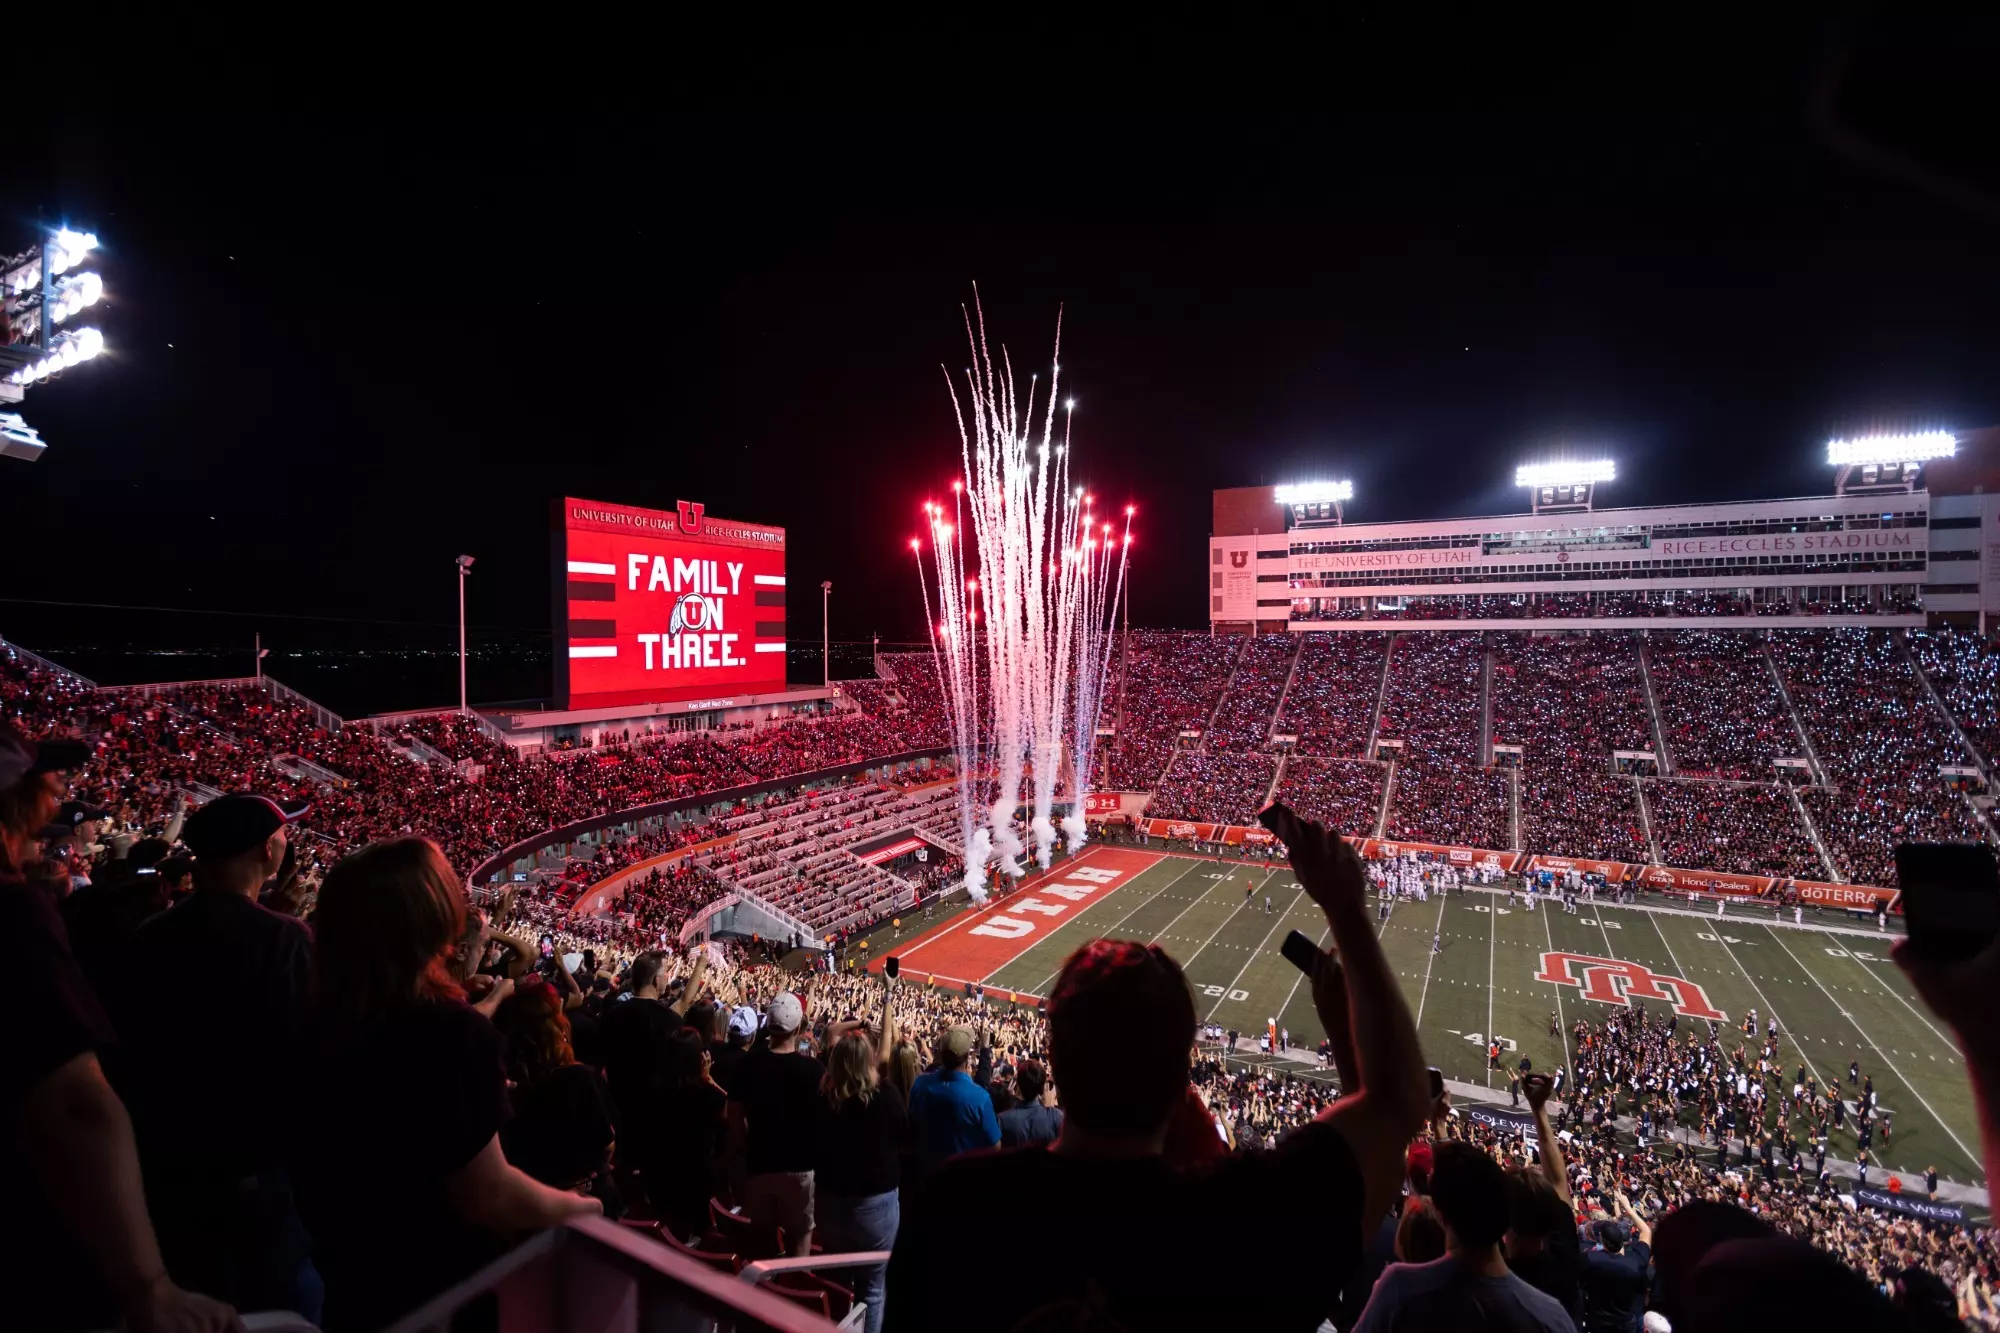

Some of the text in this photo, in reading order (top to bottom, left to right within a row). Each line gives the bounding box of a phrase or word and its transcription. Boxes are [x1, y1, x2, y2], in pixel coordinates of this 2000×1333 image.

[573, 508, 674, 531] UNIVERSITY OF UTAH
[677, 499, 705, 536] U
[705, 525, 784, 544] RICE-ECCLES STADIUM
[1663, 532, 1911, 555] RICE-ECCLES STADIUM
[1230, 551, 1249, 569] U
[1297, 551, 1472, 569] THE UNIVERSITY OF UTAH
[628, 553, 744, 595] FAMILY
[637, 633, 747, 670] THREE.
[721, 699, 734, 707] Zone
[1452, 851, 1470, 860] WCF
[1649, 875, 1750, 891] UTAH Hond Dealers
[968, 866, 1125, 939] UTAH
[1580, 917, 1622, 929] 50
[1696, 932, 1743, 944] 40
[1825, 948, 1879, 961] 30
[1203, 984, 1250, 1002] 20
[1463, 1032, 1518, 1052] 40
[1471, 1111, 1538, 1134] COLE WES
[1858, 1190, 1964, 1220] COLE WEST
